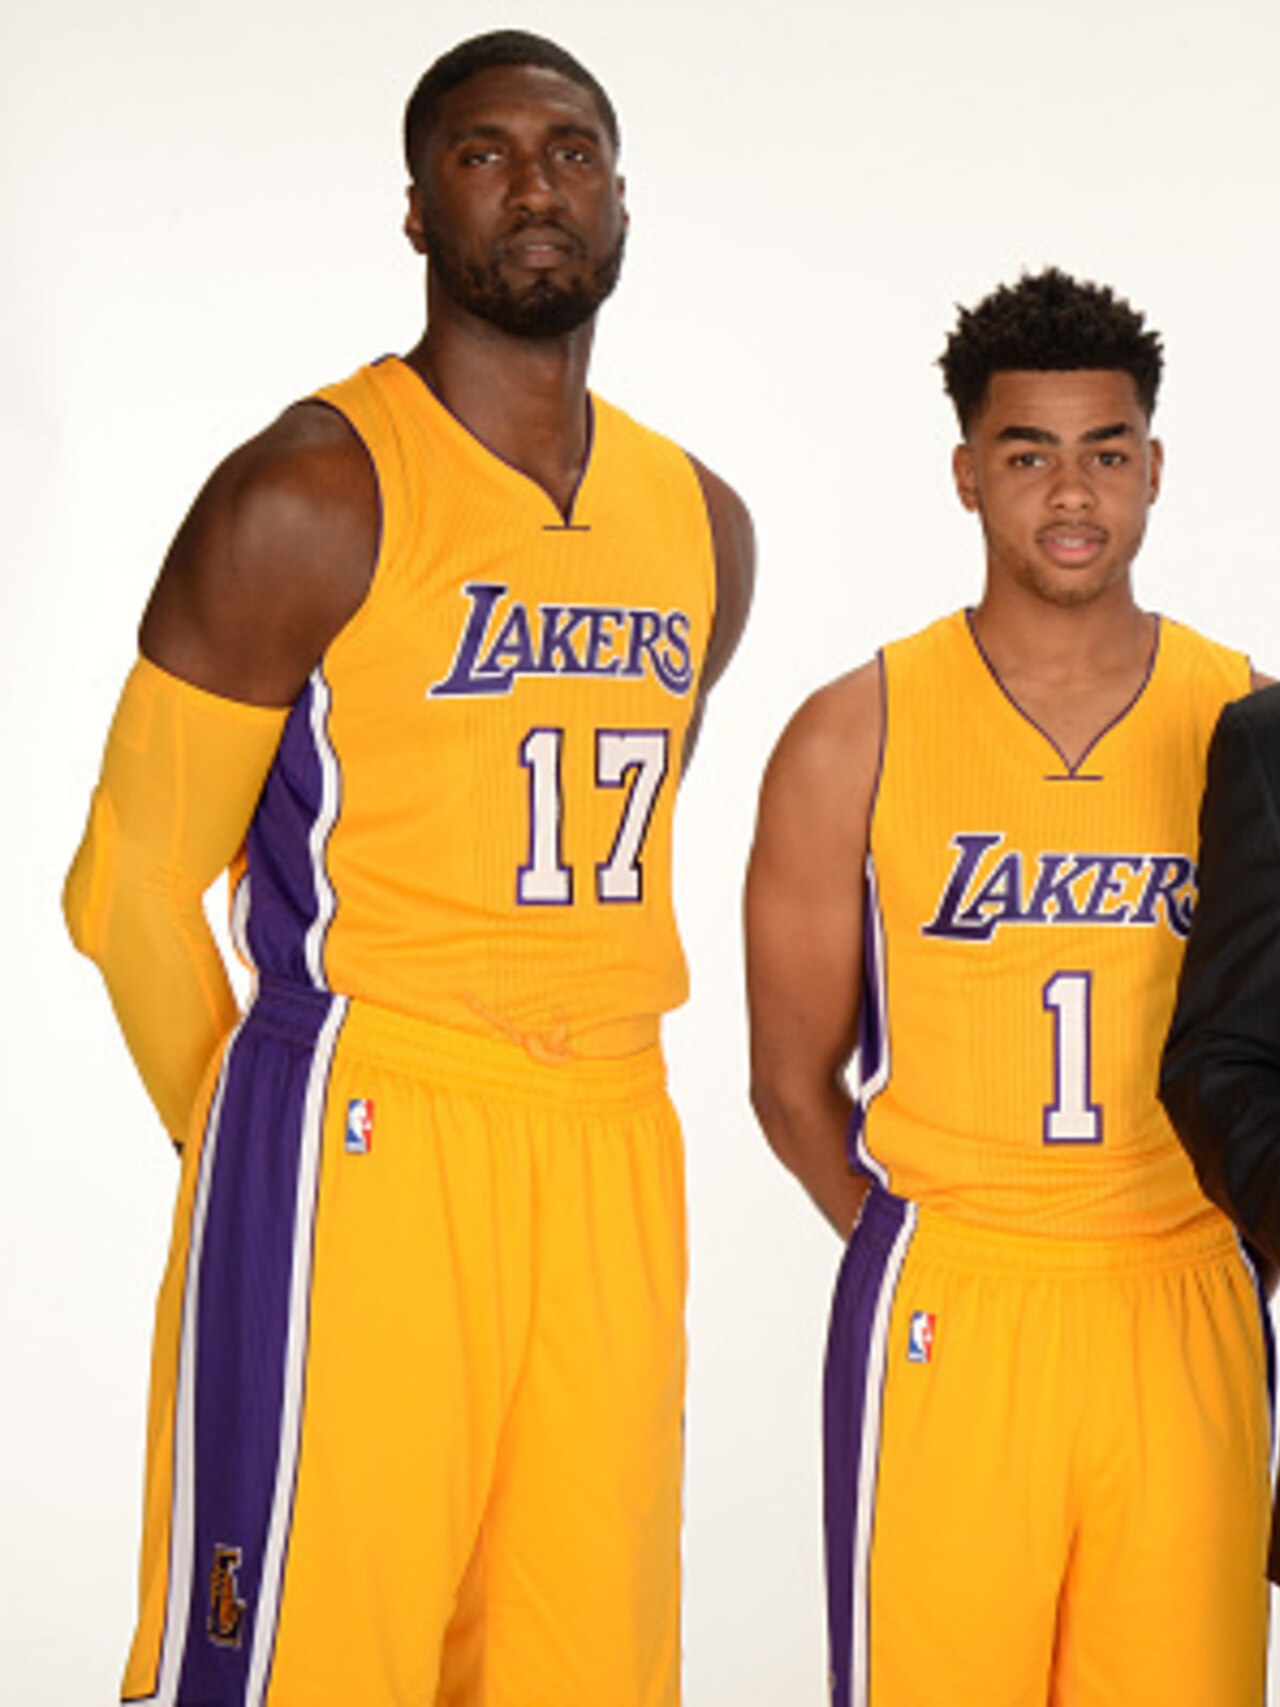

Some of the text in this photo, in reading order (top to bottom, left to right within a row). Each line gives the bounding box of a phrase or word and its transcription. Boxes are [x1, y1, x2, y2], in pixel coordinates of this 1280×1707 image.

[427, 583, 693, 698] LAKERS
[516, 727, 669, 905] 17
[1043, 970, 1103, 1144] 1
